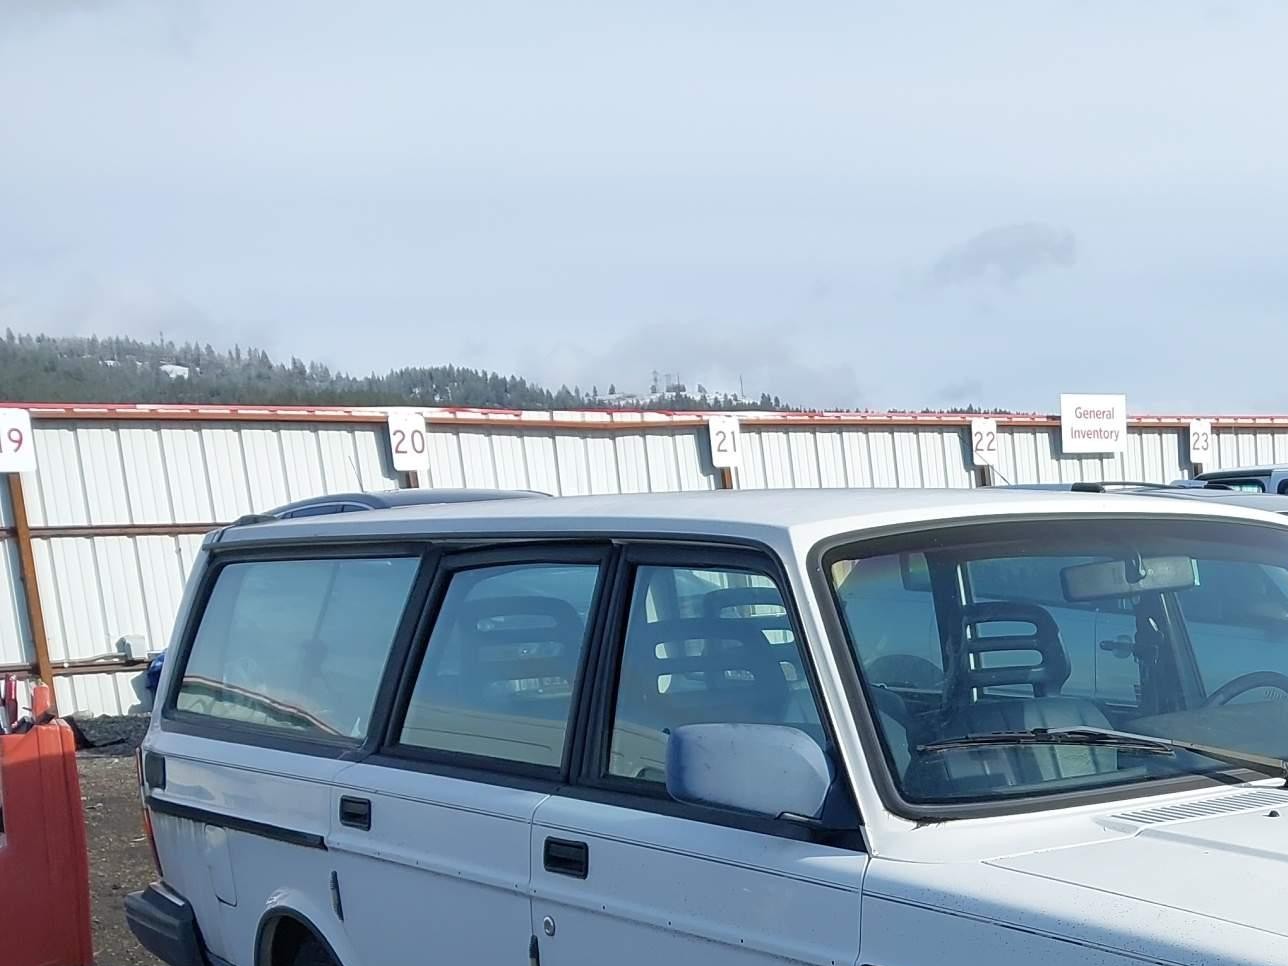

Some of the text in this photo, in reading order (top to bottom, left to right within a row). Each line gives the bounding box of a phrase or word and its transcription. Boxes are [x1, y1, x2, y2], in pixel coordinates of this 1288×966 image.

[1074, 406, 1115, 420] General
[393, 430, 425, 454] 20
[715, 431, 737, 452] 21
[974, 431, 996, 451] 22
[1070, 427, 1120, 442] Inventory
[1192, 432, 1209, 450] 23
